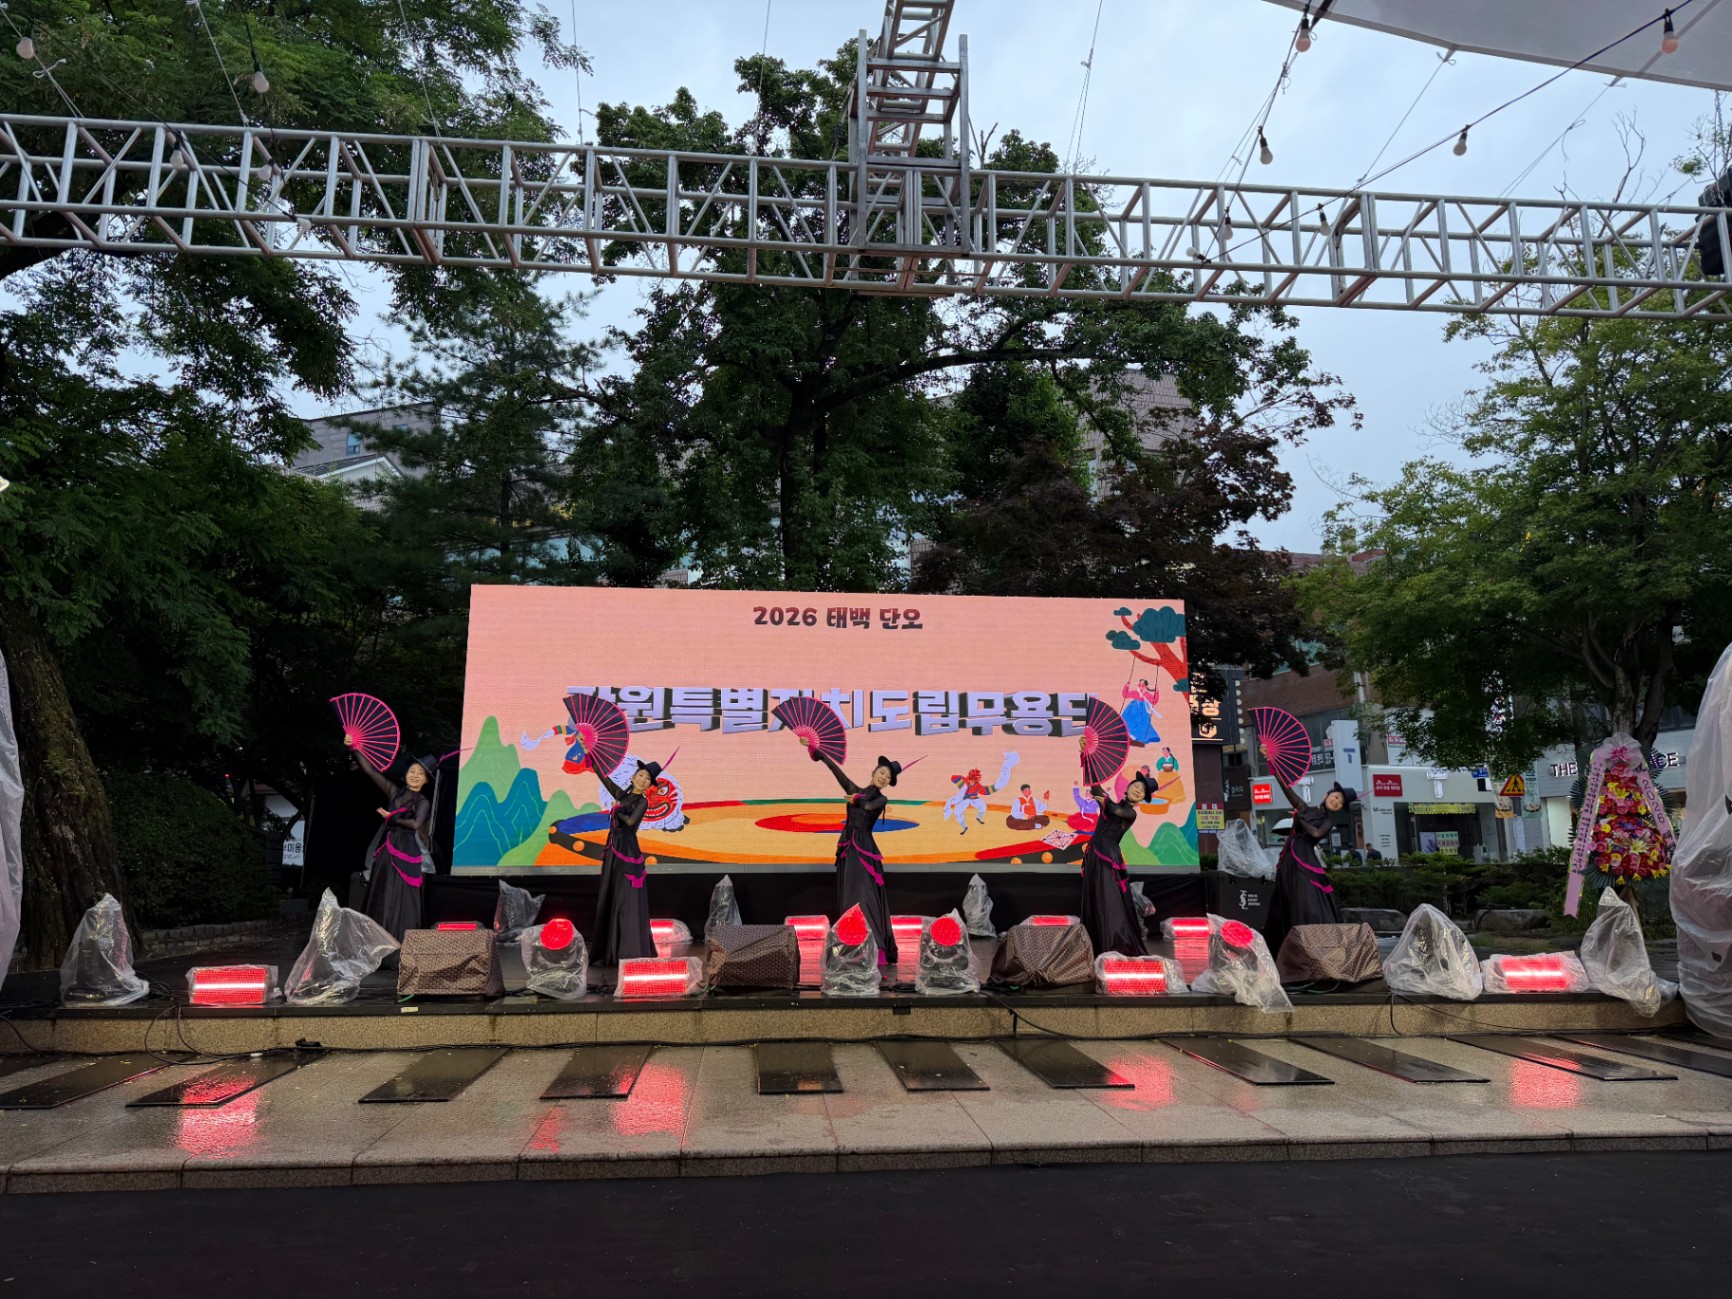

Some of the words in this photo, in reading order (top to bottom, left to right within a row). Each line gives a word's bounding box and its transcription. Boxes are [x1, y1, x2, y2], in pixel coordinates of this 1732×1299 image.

[753, 606, 818, 626] 2026
[826, 607, 871, 629] 태백
[879, 608, 923, 629] 단오
[1550, 761, 1578, 778] THE
[1641, 779, 1666, 824] 2026
